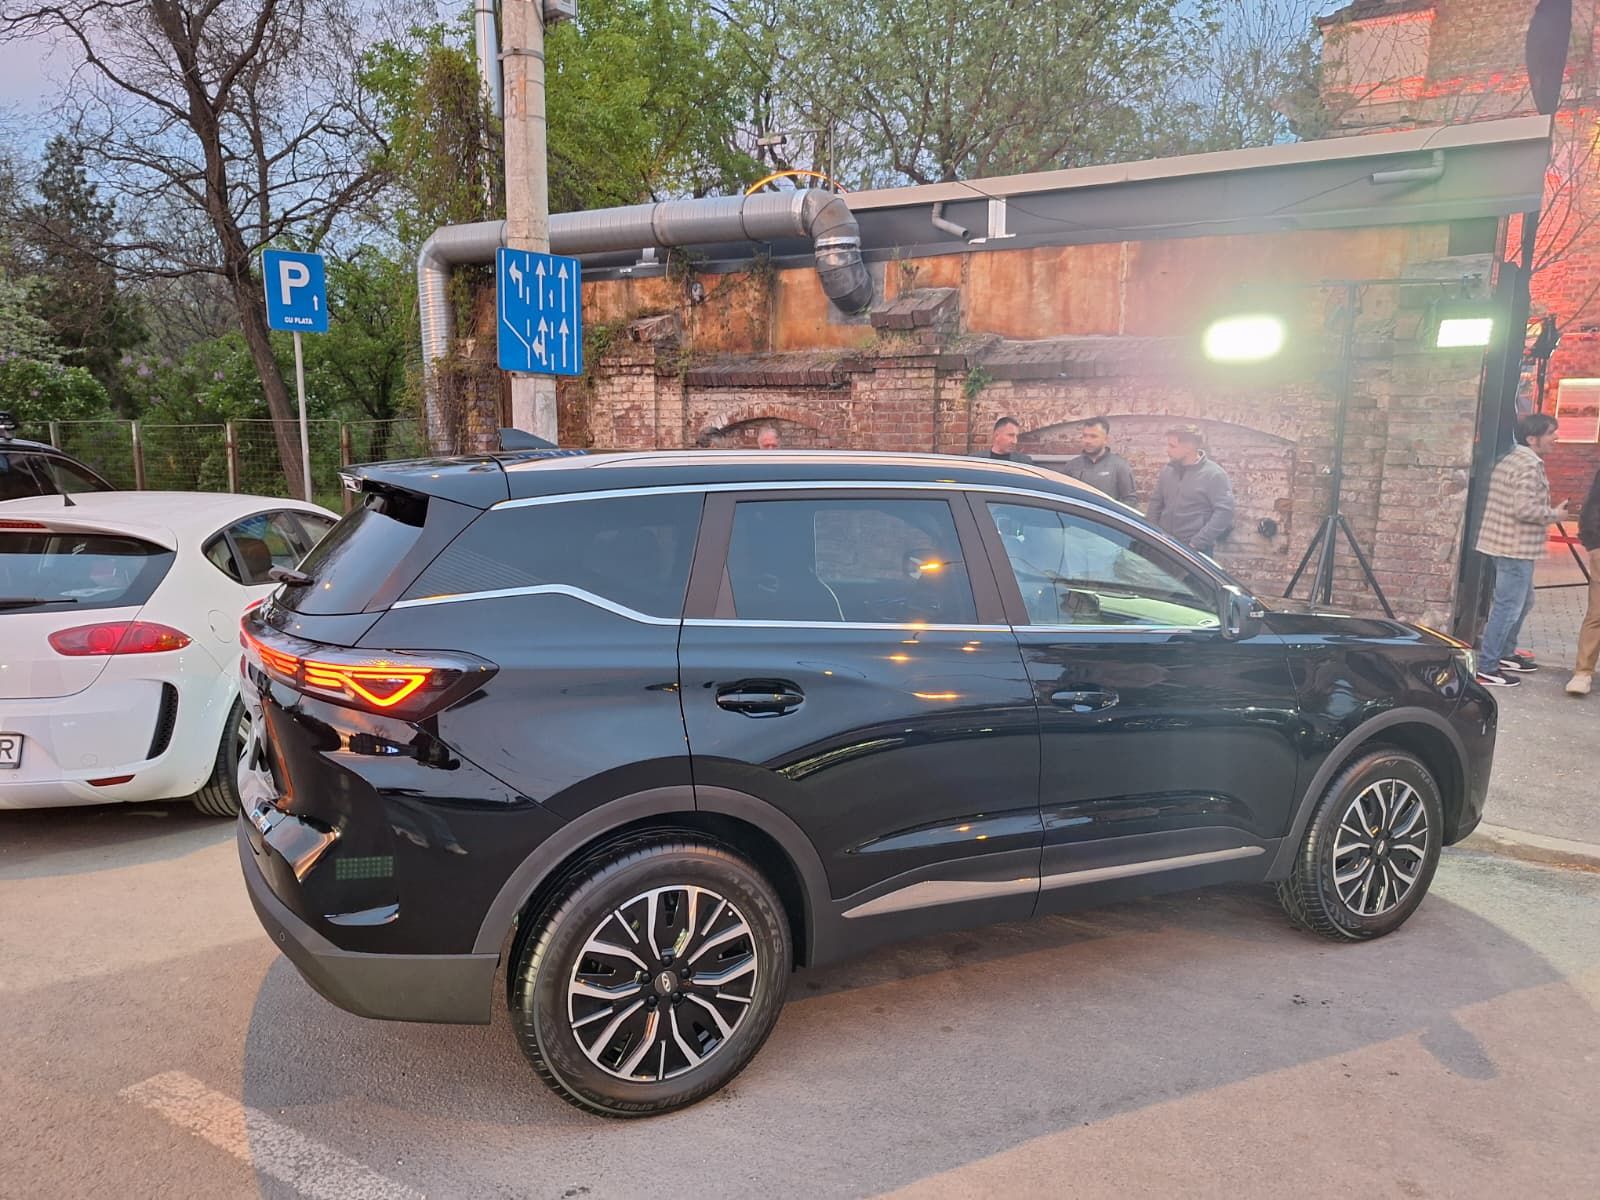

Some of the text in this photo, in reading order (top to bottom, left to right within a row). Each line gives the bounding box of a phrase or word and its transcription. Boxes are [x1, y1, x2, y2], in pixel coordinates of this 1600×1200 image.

[279, 260, 311, 305] P
[284, 316, 313, 325] CU PLATA
